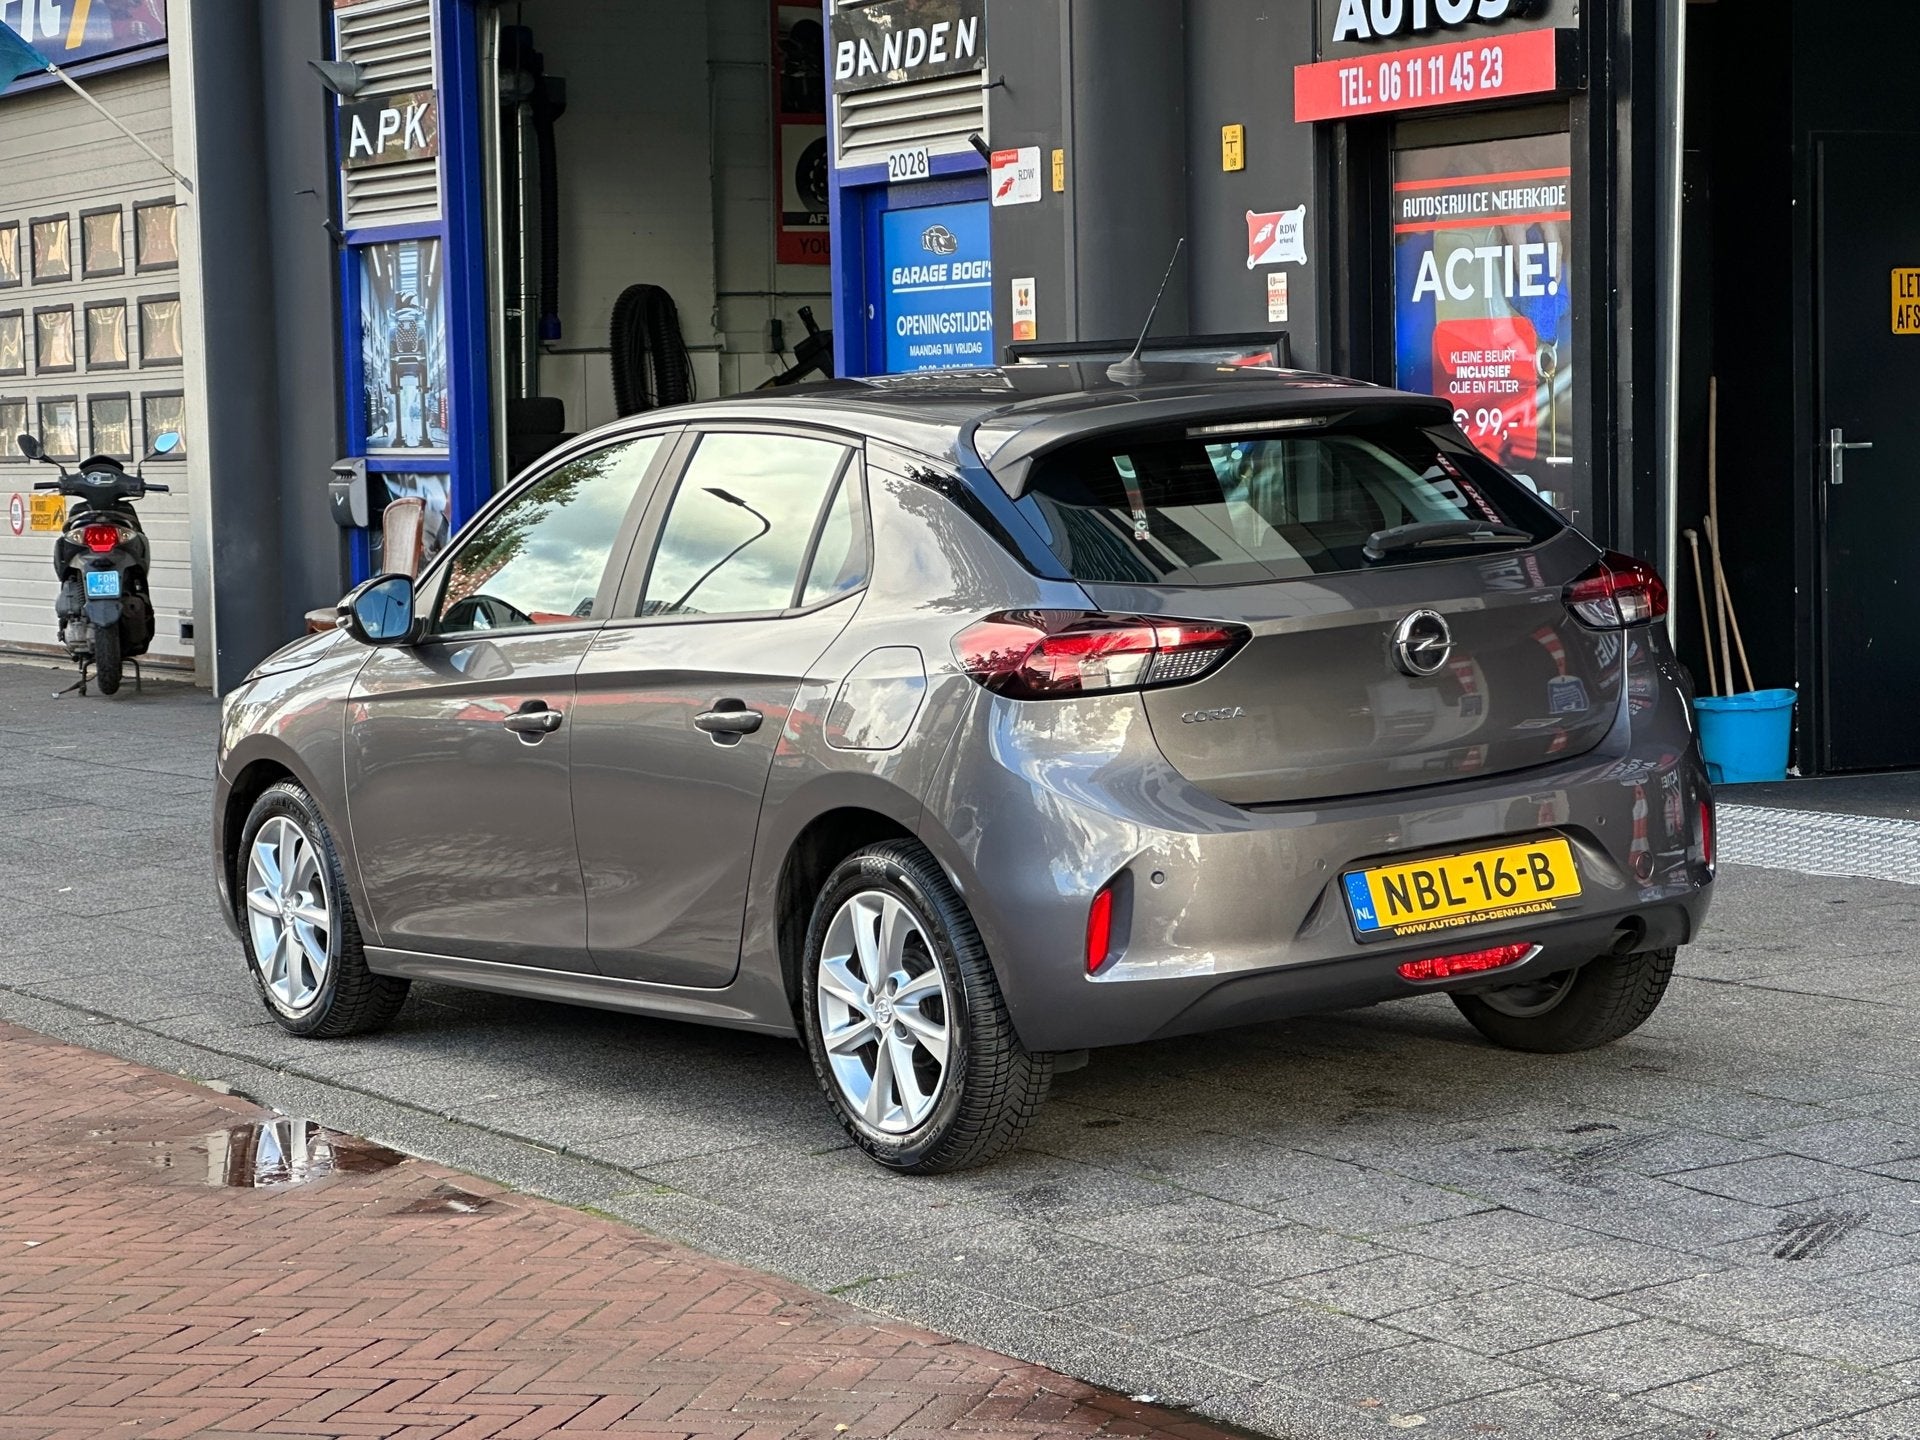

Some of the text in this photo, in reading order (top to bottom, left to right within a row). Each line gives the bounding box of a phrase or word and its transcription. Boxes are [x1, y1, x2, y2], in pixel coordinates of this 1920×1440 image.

[835, 16, 978, 80] BANDEN
[1339, 46, 1503, 107] TEL: 06 11 11 45 23
[349, 102, 430, 158] APK
[889, 151, 926, 178] 2028
[1018, 168, 1035, 181] RDW
[1403, 185, 1567, 218] AUTOSERVICE NEHERKADE
[1279, 223, 1297, 235] RDW
[892, 263, 948, 285] GARAGE
[1412, 242, 1558, 303] ACTIE!
[896, 310, 993, 337] OPENINGSTIJDEN
[909, 345, 942, 357] MAANDAG
[955, 342, 983, 354] VRIJDAG
[1451, 350, 1517, 364] KLEINE BEURT
[1457, 365, 1511, 379] INCLUSIEF
[1450, 381, 1519, 394] OLIE EN FILTER
[1476, 407, 1518, 440] 99,-
[1181, 706, 1246, 724] CORSA
[1357, 852, 1556, 921] NL NBL-16-B
[1394, 901, 1557, 937] WWW.AUTOSTAD-DENHAAG.NL
